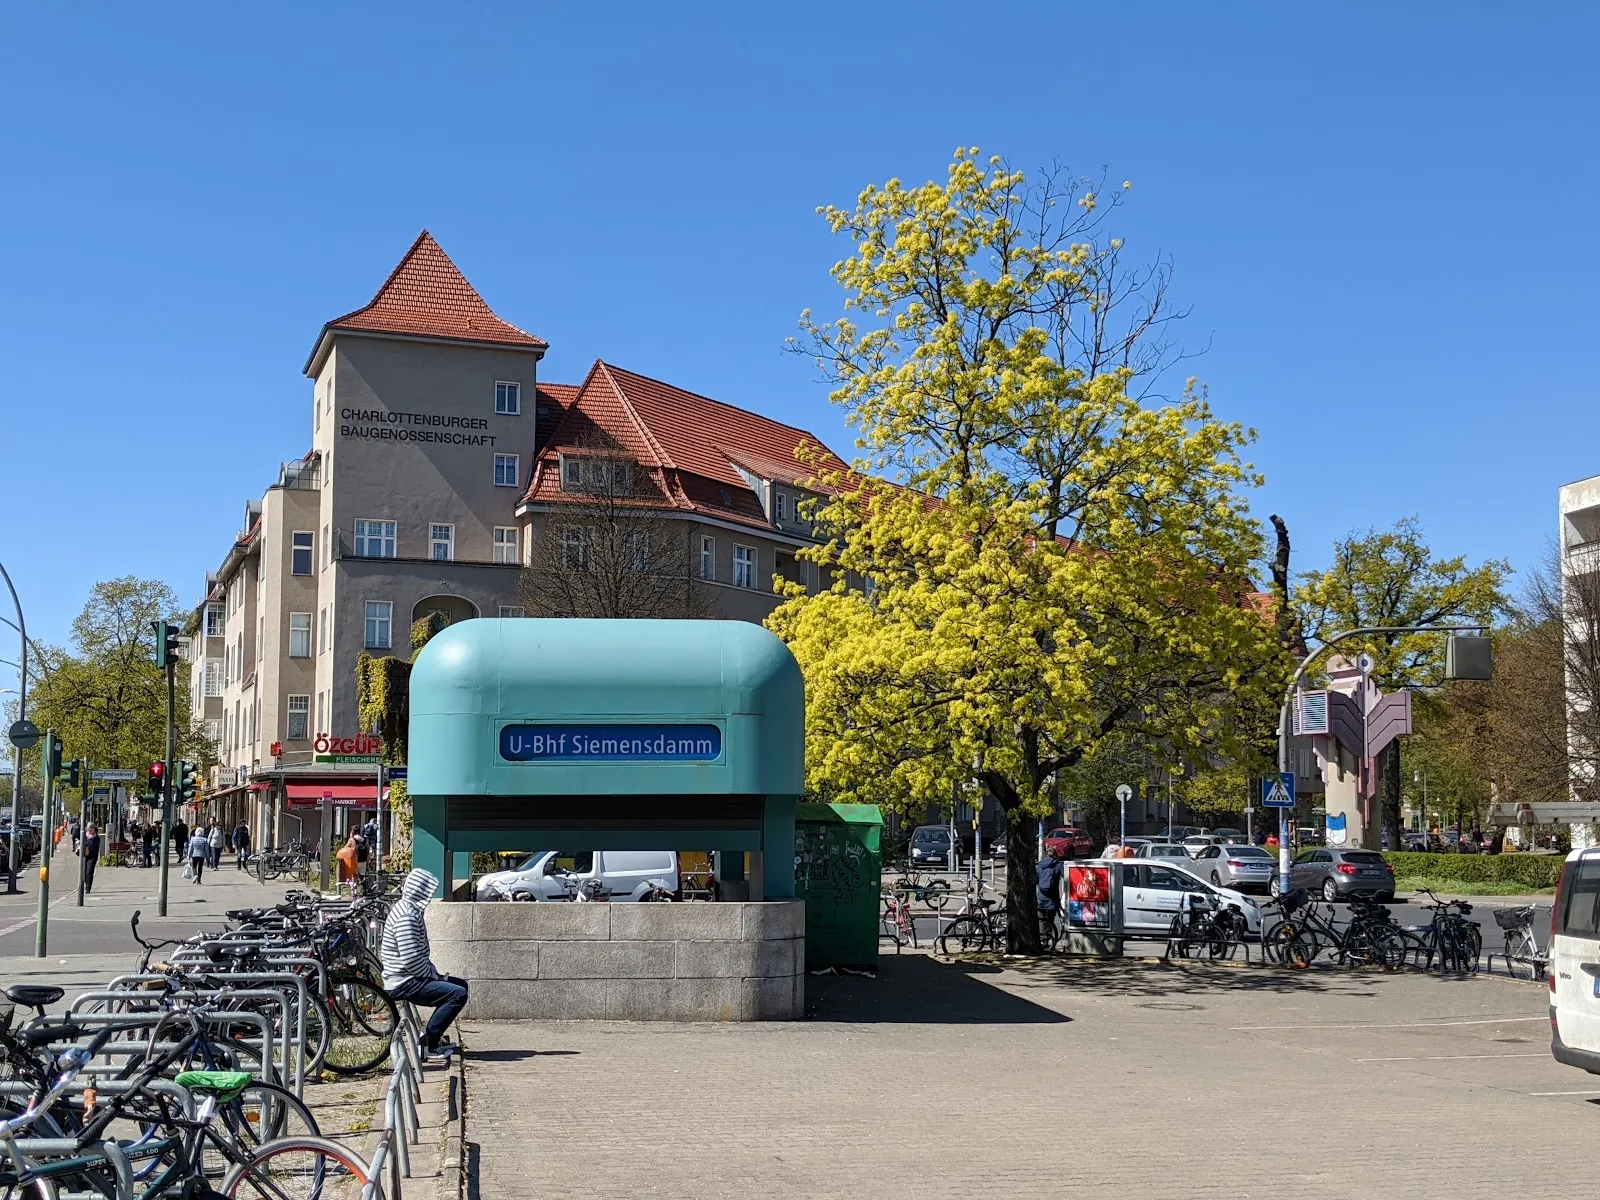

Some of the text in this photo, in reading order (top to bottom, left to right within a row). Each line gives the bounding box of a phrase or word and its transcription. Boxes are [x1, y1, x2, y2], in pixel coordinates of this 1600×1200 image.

[341, 408, 488, 430] CHARLOTTENBURGER
[340, 425, 497, 447] BAUGENOSSENSCHAFT
[509, 734, 713, 754] U-Bhf Siemensdamm
